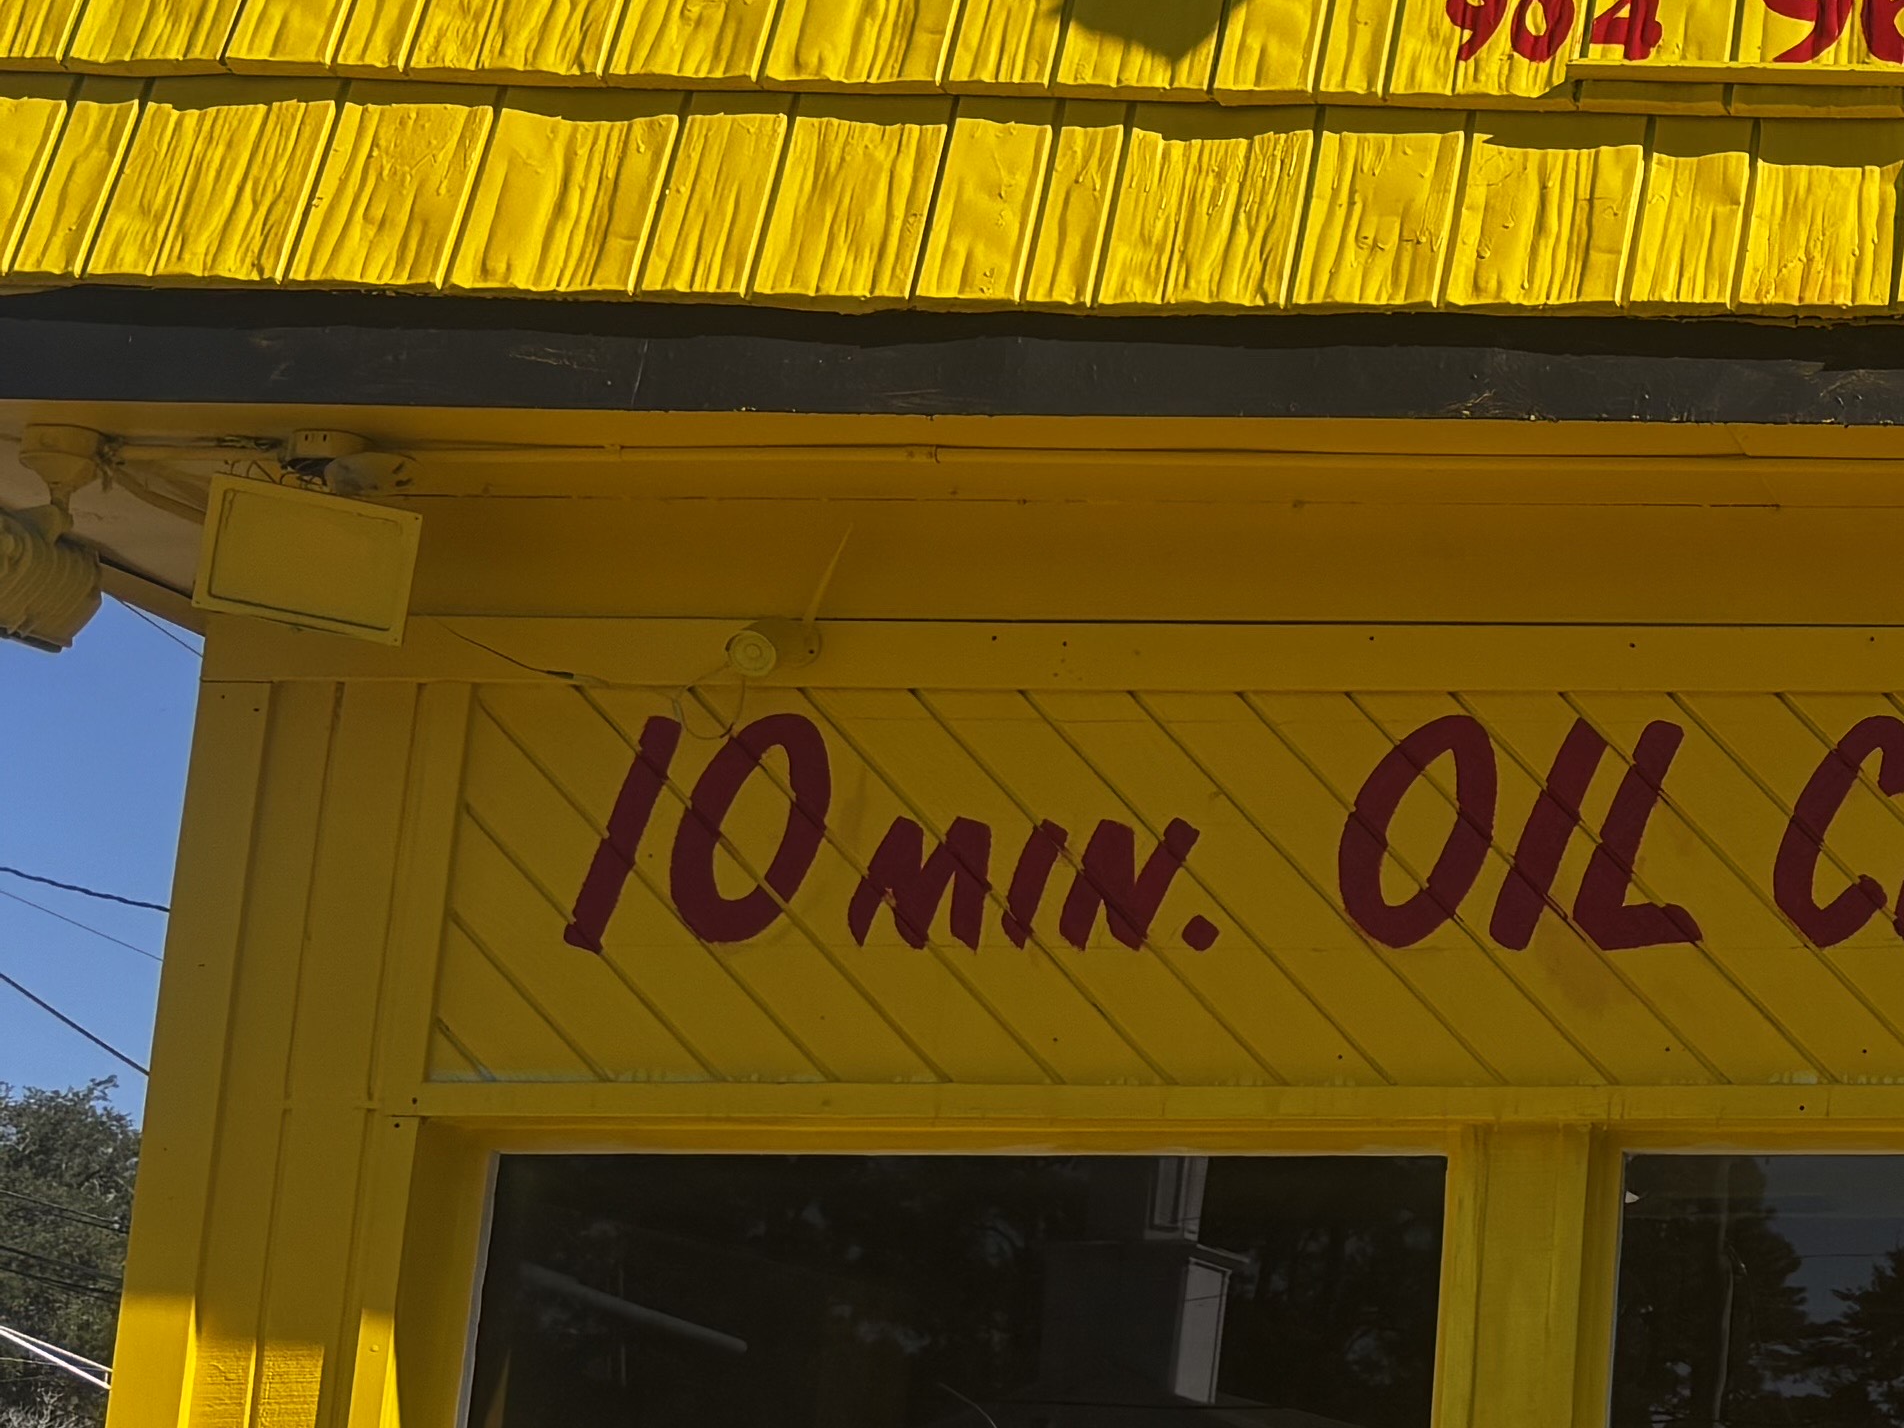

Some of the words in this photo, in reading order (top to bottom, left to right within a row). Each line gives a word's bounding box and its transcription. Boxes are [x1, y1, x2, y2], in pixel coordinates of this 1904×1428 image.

[564, 713, 832, 951] 10
[848, 816, 1219, 951] MIN.
[1337, 714, 1702, 952] OIL
